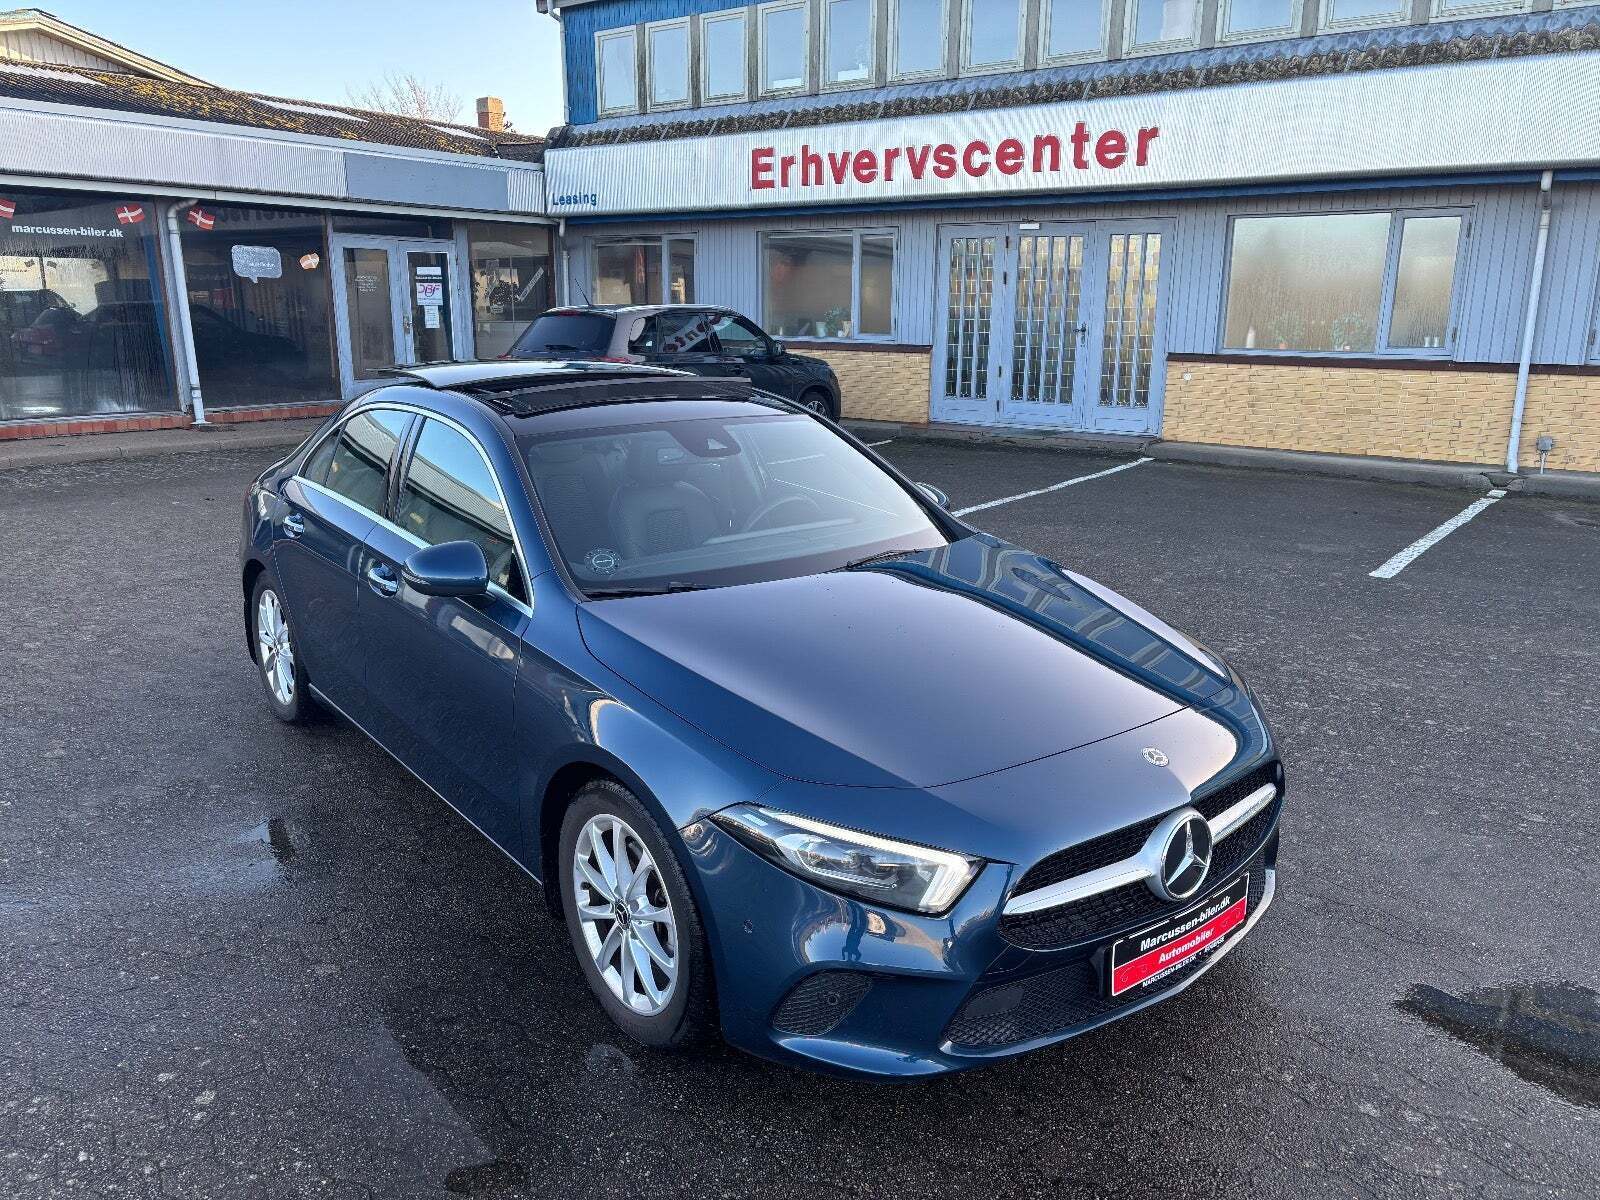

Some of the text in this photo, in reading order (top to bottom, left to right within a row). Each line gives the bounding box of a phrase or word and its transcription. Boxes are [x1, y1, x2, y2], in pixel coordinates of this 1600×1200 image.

[751, 121, 1160, 190] Erhvervscenter
[552, 191, 597, 206] Leasing
[11, 224, 124, 238] marcussen-biler.dk
[1140, 895, 1231, 952] Marcussen-biler.dk
[1158, 928, 1215, 964] Automobiler
